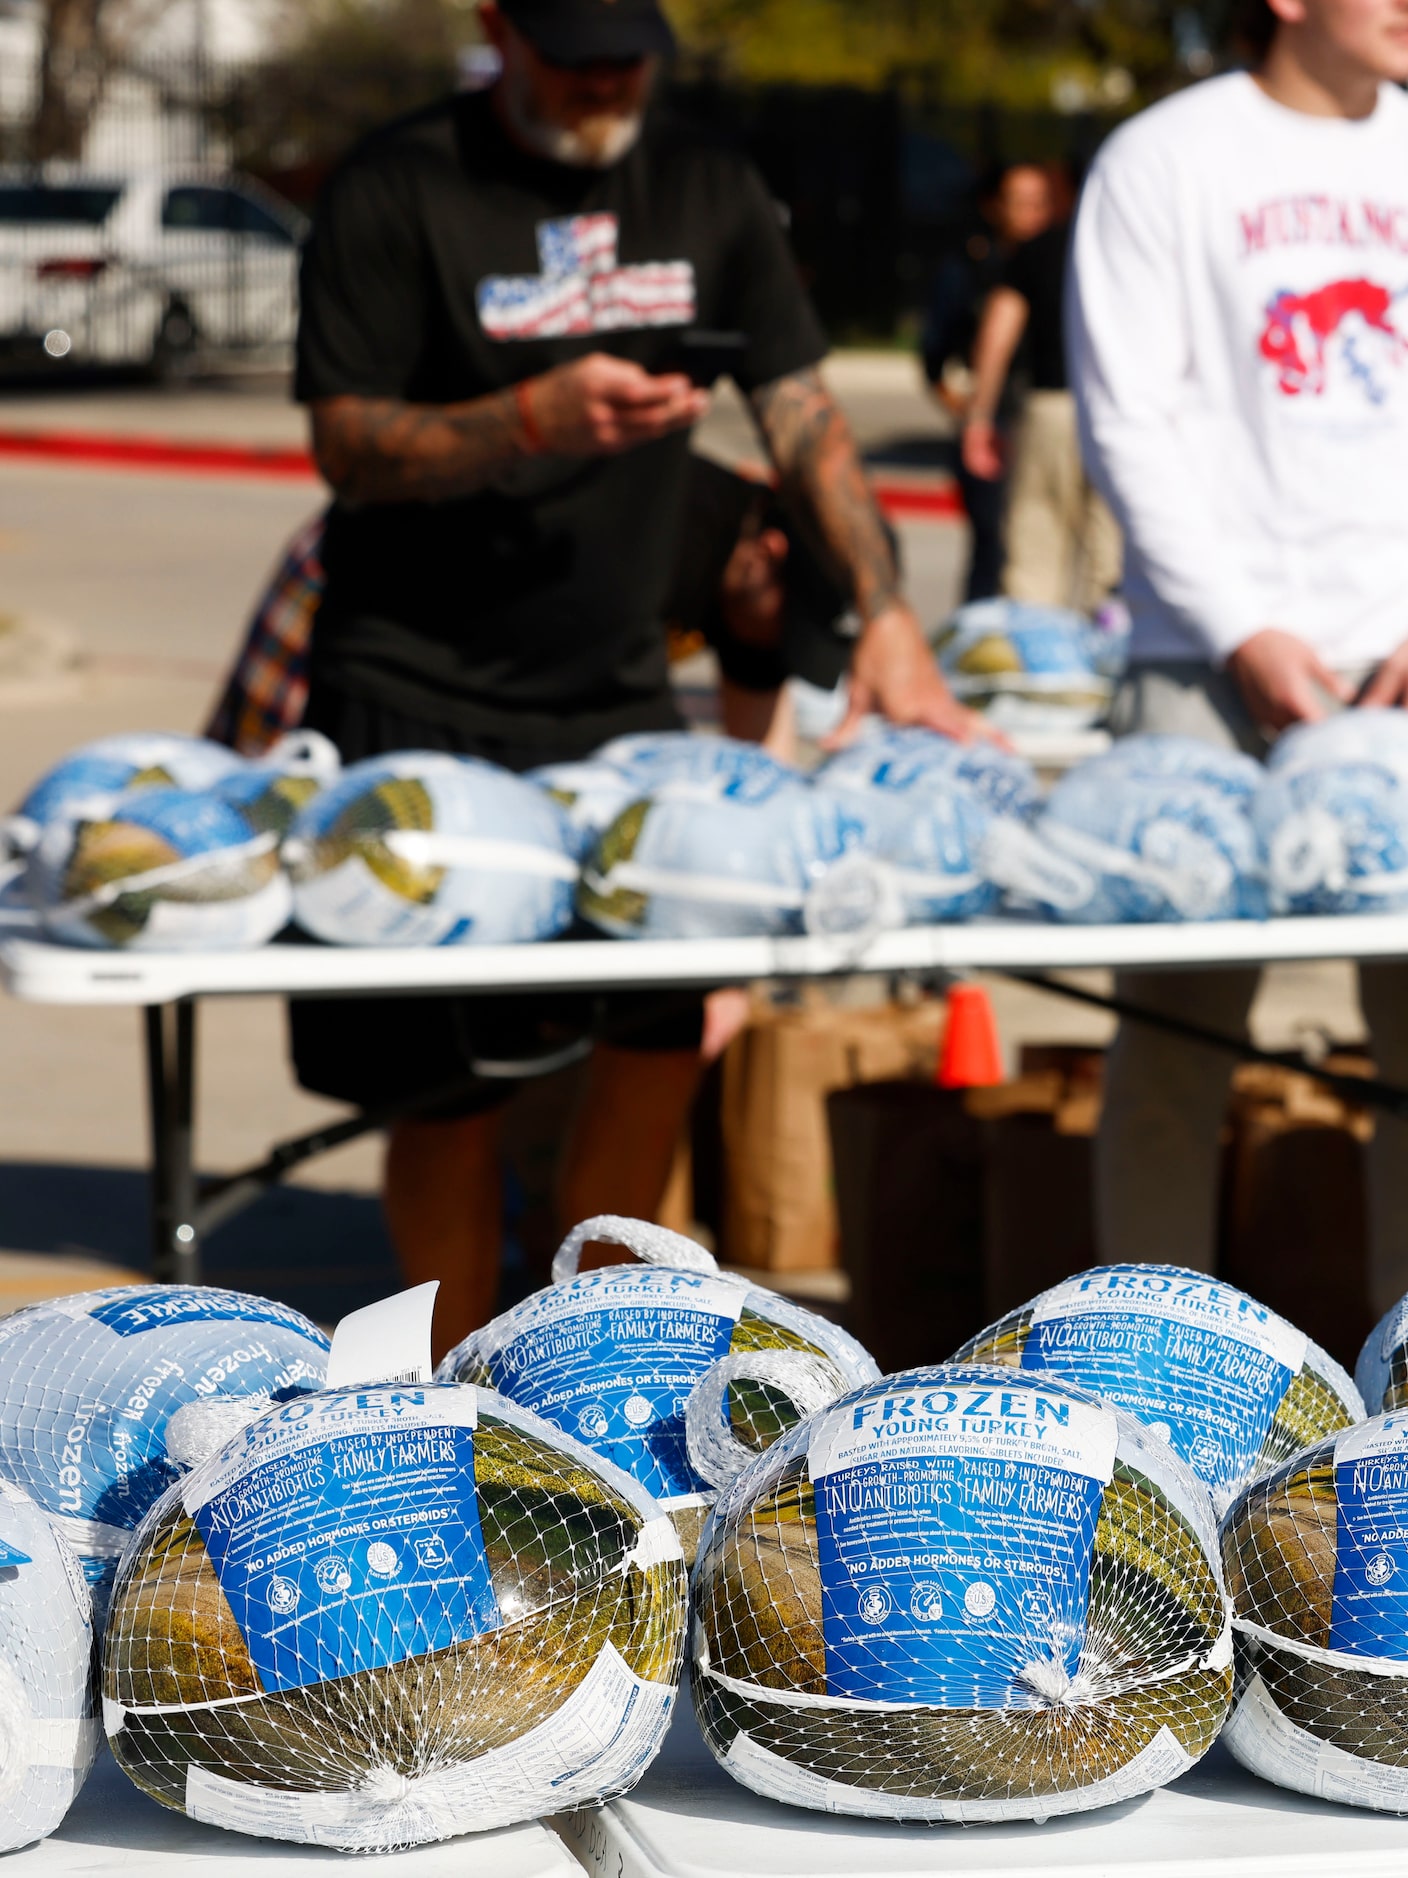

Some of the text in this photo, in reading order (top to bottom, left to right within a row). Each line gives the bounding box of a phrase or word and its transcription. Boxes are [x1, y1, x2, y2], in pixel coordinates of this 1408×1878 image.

[604, 1286, 680, 1294] TURKEY
[1080, 1276, 1268, 1325] FROZEN
[609, 1309, 720, 1327] RAISED BY INDEPENDENT
[1097, 1290, 1248, 1322] YOUNG TURKEY
[610, 1321, 717, 1344] FAMILY FARMERS
[1070, 1331, 1154, 1353] ANTIBIOTICS
[1073, 1321, 1160, 1334] GROWTH-PROMOTING
[529, 1330, 601, 1364] ANTIBIOTICS
[1168, 1323, 1280, 1375] RAISED BY INDEPENDENT
[194, 1340, 274, 1396] frozen
[1164, 1335, 1273, 1393] FAMILY FARMERS
[123, 1357, 185, 1422] frozen
[541, 1375, 651, 1406] ADDED HORMONES OR
[1105, 1389, 1167, 1409] HORMONES
[1169, 1401, 1184, 1412] OR
[853, 1391, 1069, 1430] FROZEN
[240, 1408, 405, 1459] YOUNG TURKEY
[330, 1428, 457, 1454] RAISED BY INDEPENDENT
[872, 1417, 1047, 1439] YOUNG TURKEY
[58, 1401, 109, 1513] frozen
[111, 1428, 132, 1499] frozen
[248, 1455, 264, 1468] AND
[265, 1444, 301, 1460] NATURAL
[334, 1440, 456, 1478] FAMILY FARMERS
[838, 1436, 1083, 1461] BASTED WITH OF SALT,
[852, 1444, 1022, 1463] SUGAR AND NATURAL FLAVORING. GIBLETS
[1356, 1455, 1398, 1467] TURKEYS
[209, 1480, 249, 1508] TURKEYS
[293, 1446, 321, 1461] WITH
[239, 1455, 323, 1498] GROWTH-PROMOTING
[832, 1460, 955, 1484] TURKEYS RAISED WITH
[863, 1470, 954, 1488] GROWTH-PROMOTING
[964, 1460, 1090, 1494] RAISED BY INDEPENDENT
[1353, 1465, 1383, 1495] NO
[241, 1467, 325, 1517] ANTIBIOTICS
[831, 1479, 952, 1517] NO ANTIBIOTICS
[964, 1478, 1083, 1521] FAMILY FARMERS
[267, 1542, 305, 1565] ADDED
[308, 1523, 370, 1548] HORMONES
[372, 1518, 388, 1531] OR
[426, 1547, 437, 1558] A
[871, 1556, 910, 1571] ADDED
[913, 1554, 981, 1568] HORMONES
[986, 1557, 1001, 1569] OR
[1030, 1602, 1041, 1611] A
